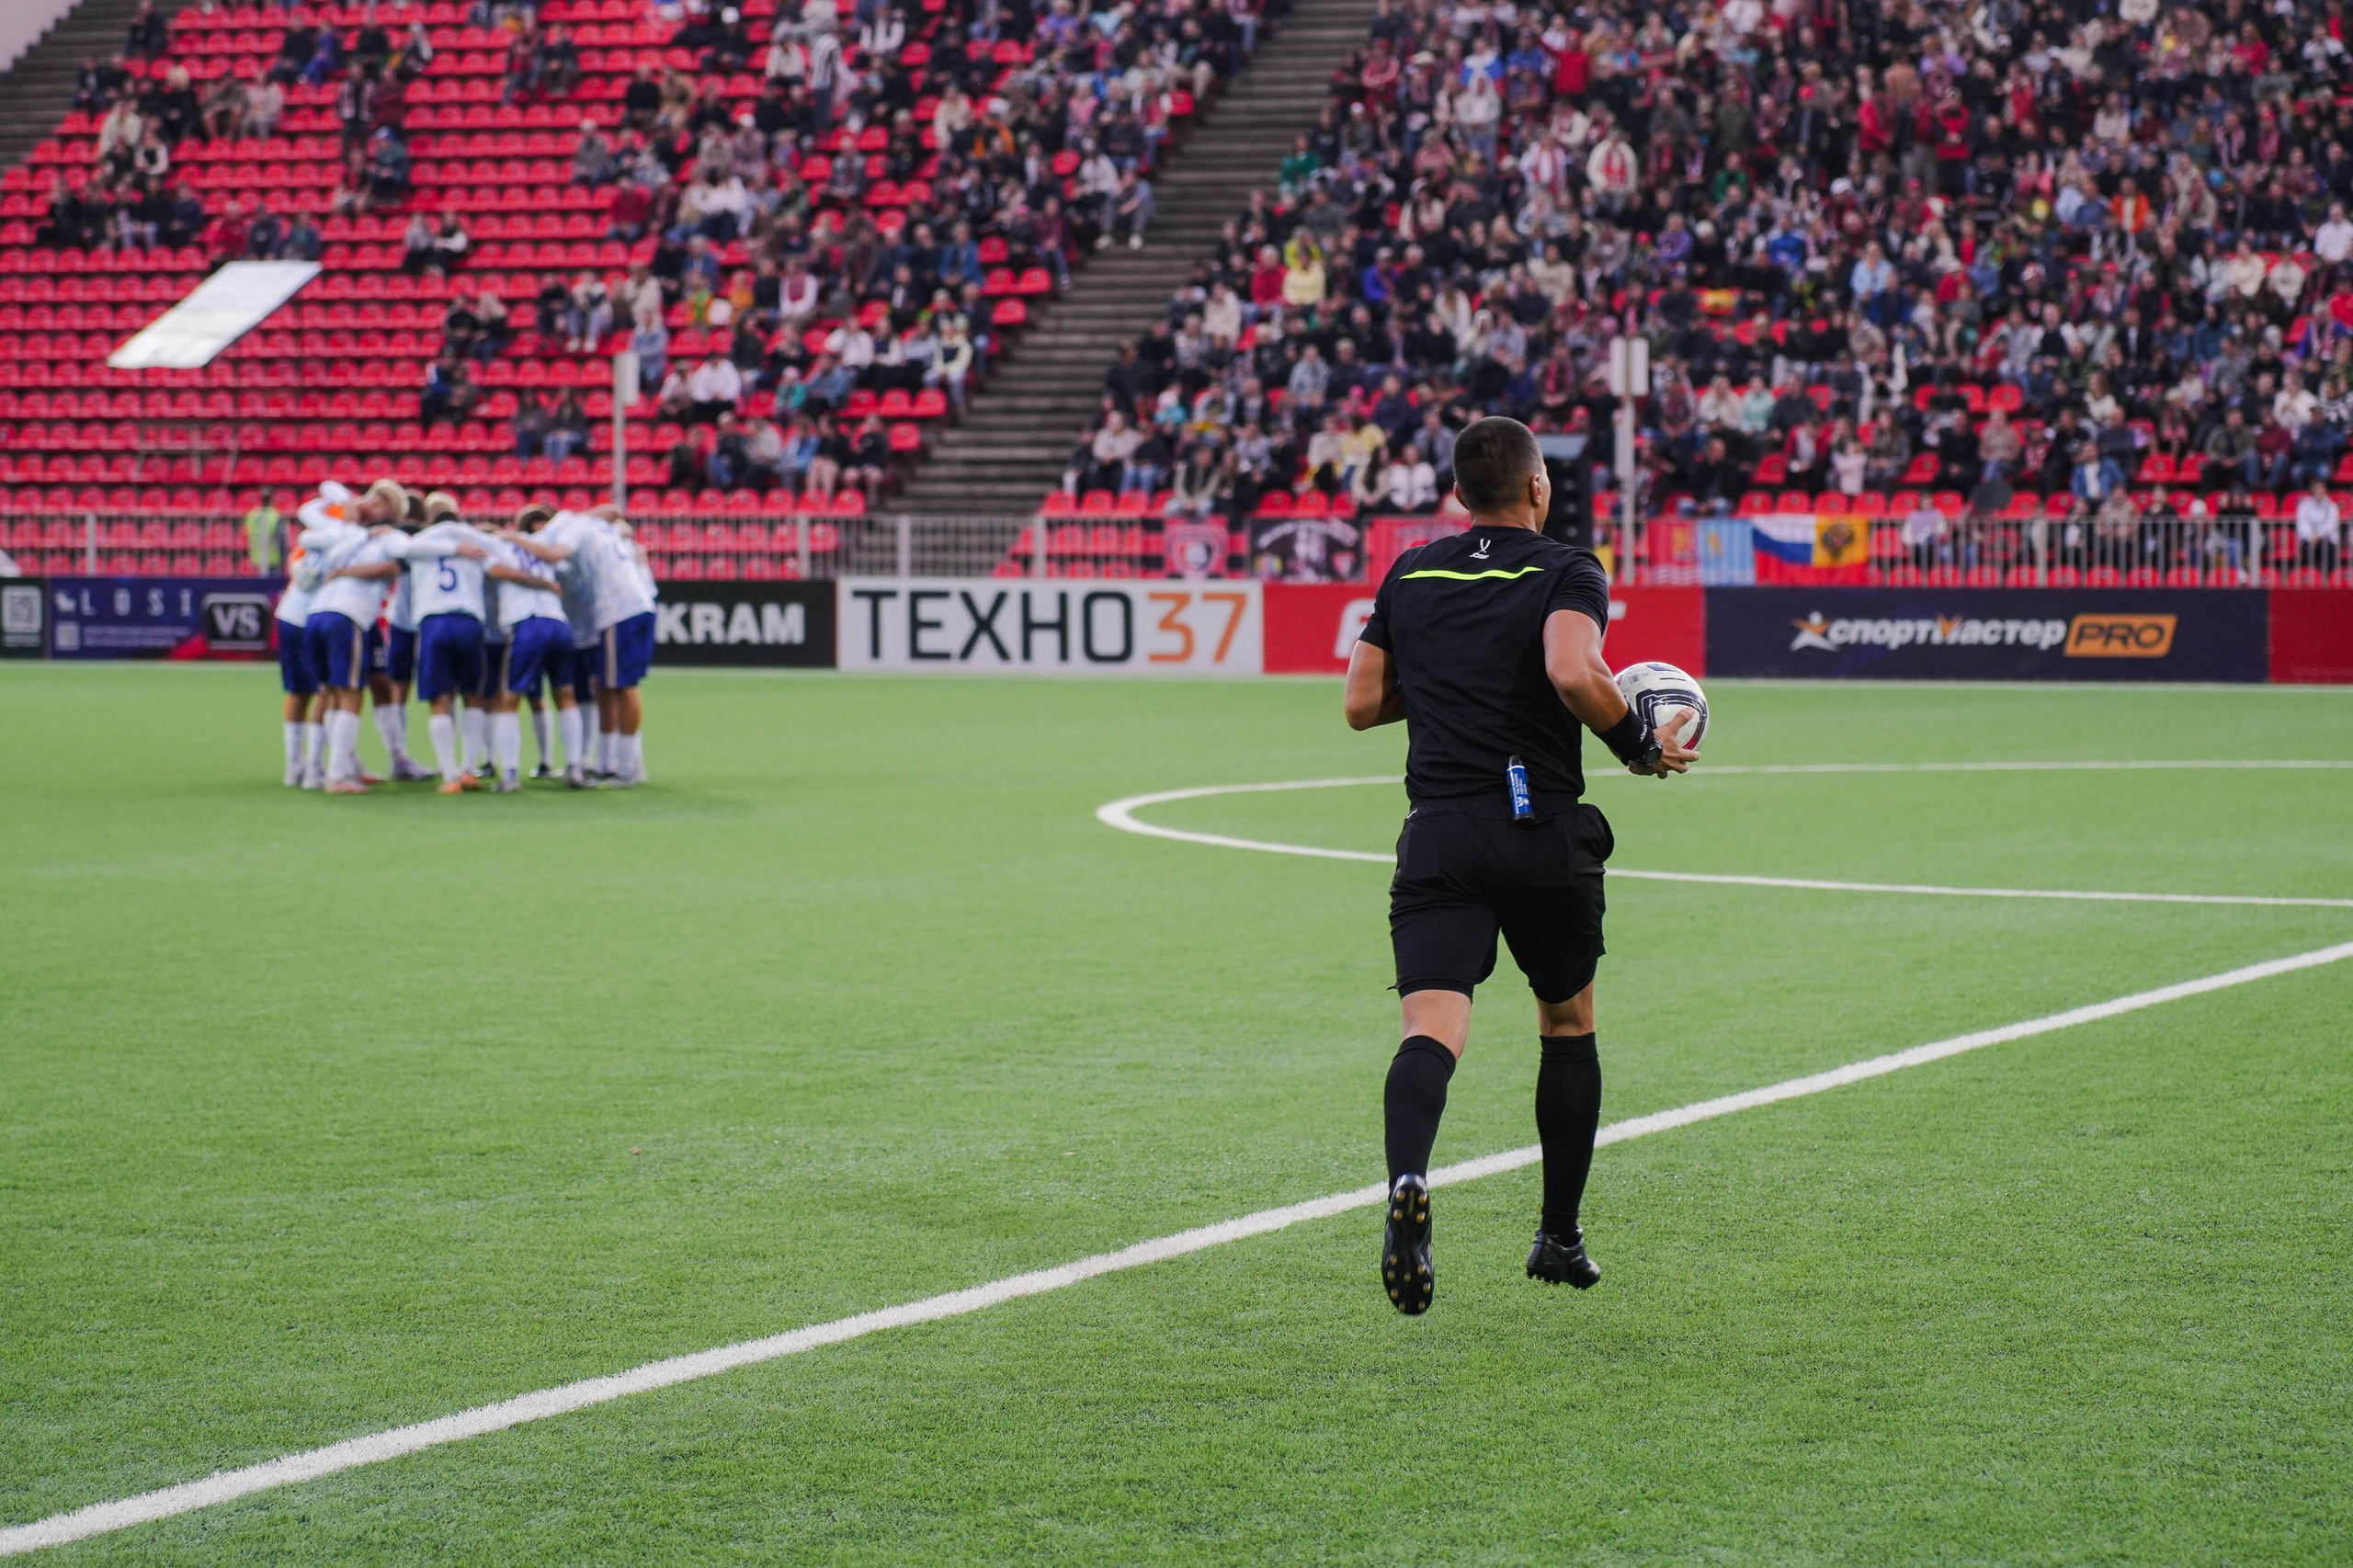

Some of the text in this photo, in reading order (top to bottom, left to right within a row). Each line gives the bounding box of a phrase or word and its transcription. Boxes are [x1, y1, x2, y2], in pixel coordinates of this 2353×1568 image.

[438, 556, 458, 593] 5
[210, 604, 261, 641] VS
[2075, 622, 2165, 649] PRO
